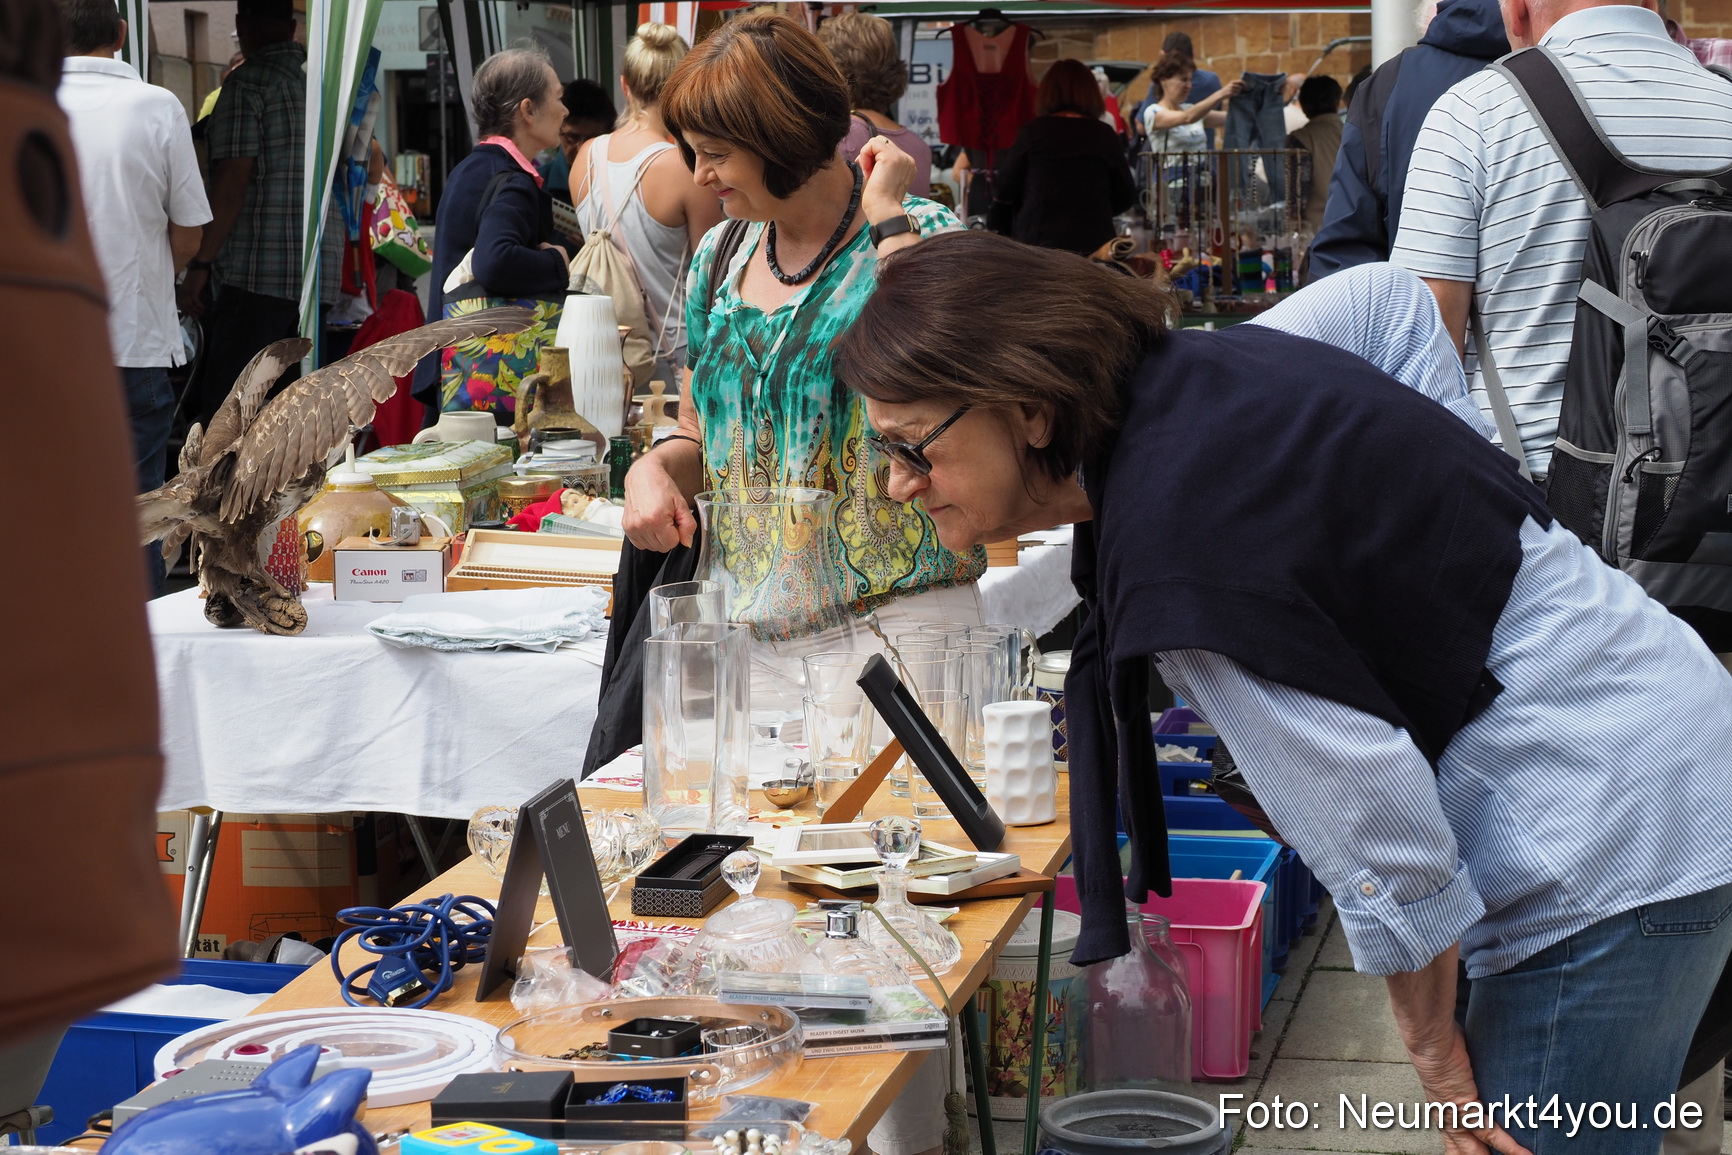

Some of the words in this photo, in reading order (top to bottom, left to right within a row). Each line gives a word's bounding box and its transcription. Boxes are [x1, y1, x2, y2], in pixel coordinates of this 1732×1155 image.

[351, 568, 387, 577] Canon
[556, 822, 570, 839] MENU
[728, 993, 752, 1001] READER'S
